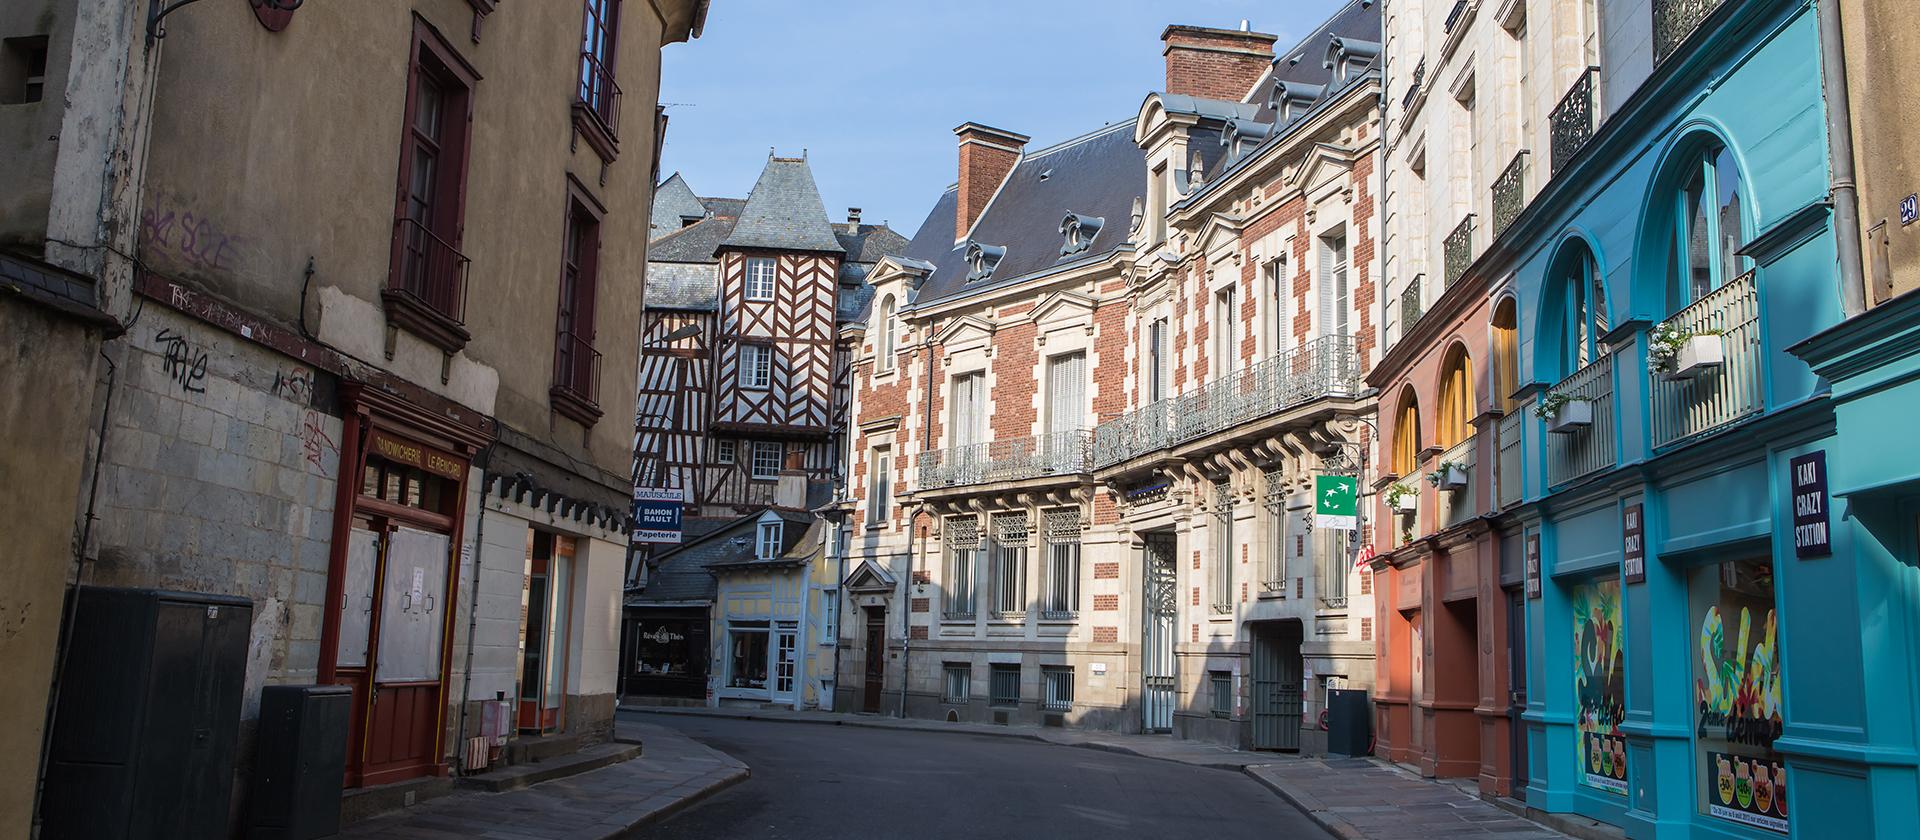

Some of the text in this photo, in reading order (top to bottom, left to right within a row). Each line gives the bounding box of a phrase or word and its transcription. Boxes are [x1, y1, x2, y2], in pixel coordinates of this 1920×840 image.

[1901, 197, 1915, 222] 29
[377, 436, 421, 465] SANDWICHERIE
[428, 452, 436, 469] LE
[1797, 461, 1816, 487] KAKI
[636, 491, 682, 499] MAJUSCULE
[1796, 491, 1822, 517] CRAZY
[644, 508, 672, 516] BAHON
[644, 515, 672, 523] RAULT
[1626, 511, 1638, 530] KAKI
[637, 530, 677, 538] Papeterie
[1625, 533, 1641, 553] CRAZY
[1795, 521, 1827, 548] STATION
[1625, 557, 1643, 577] STATION
